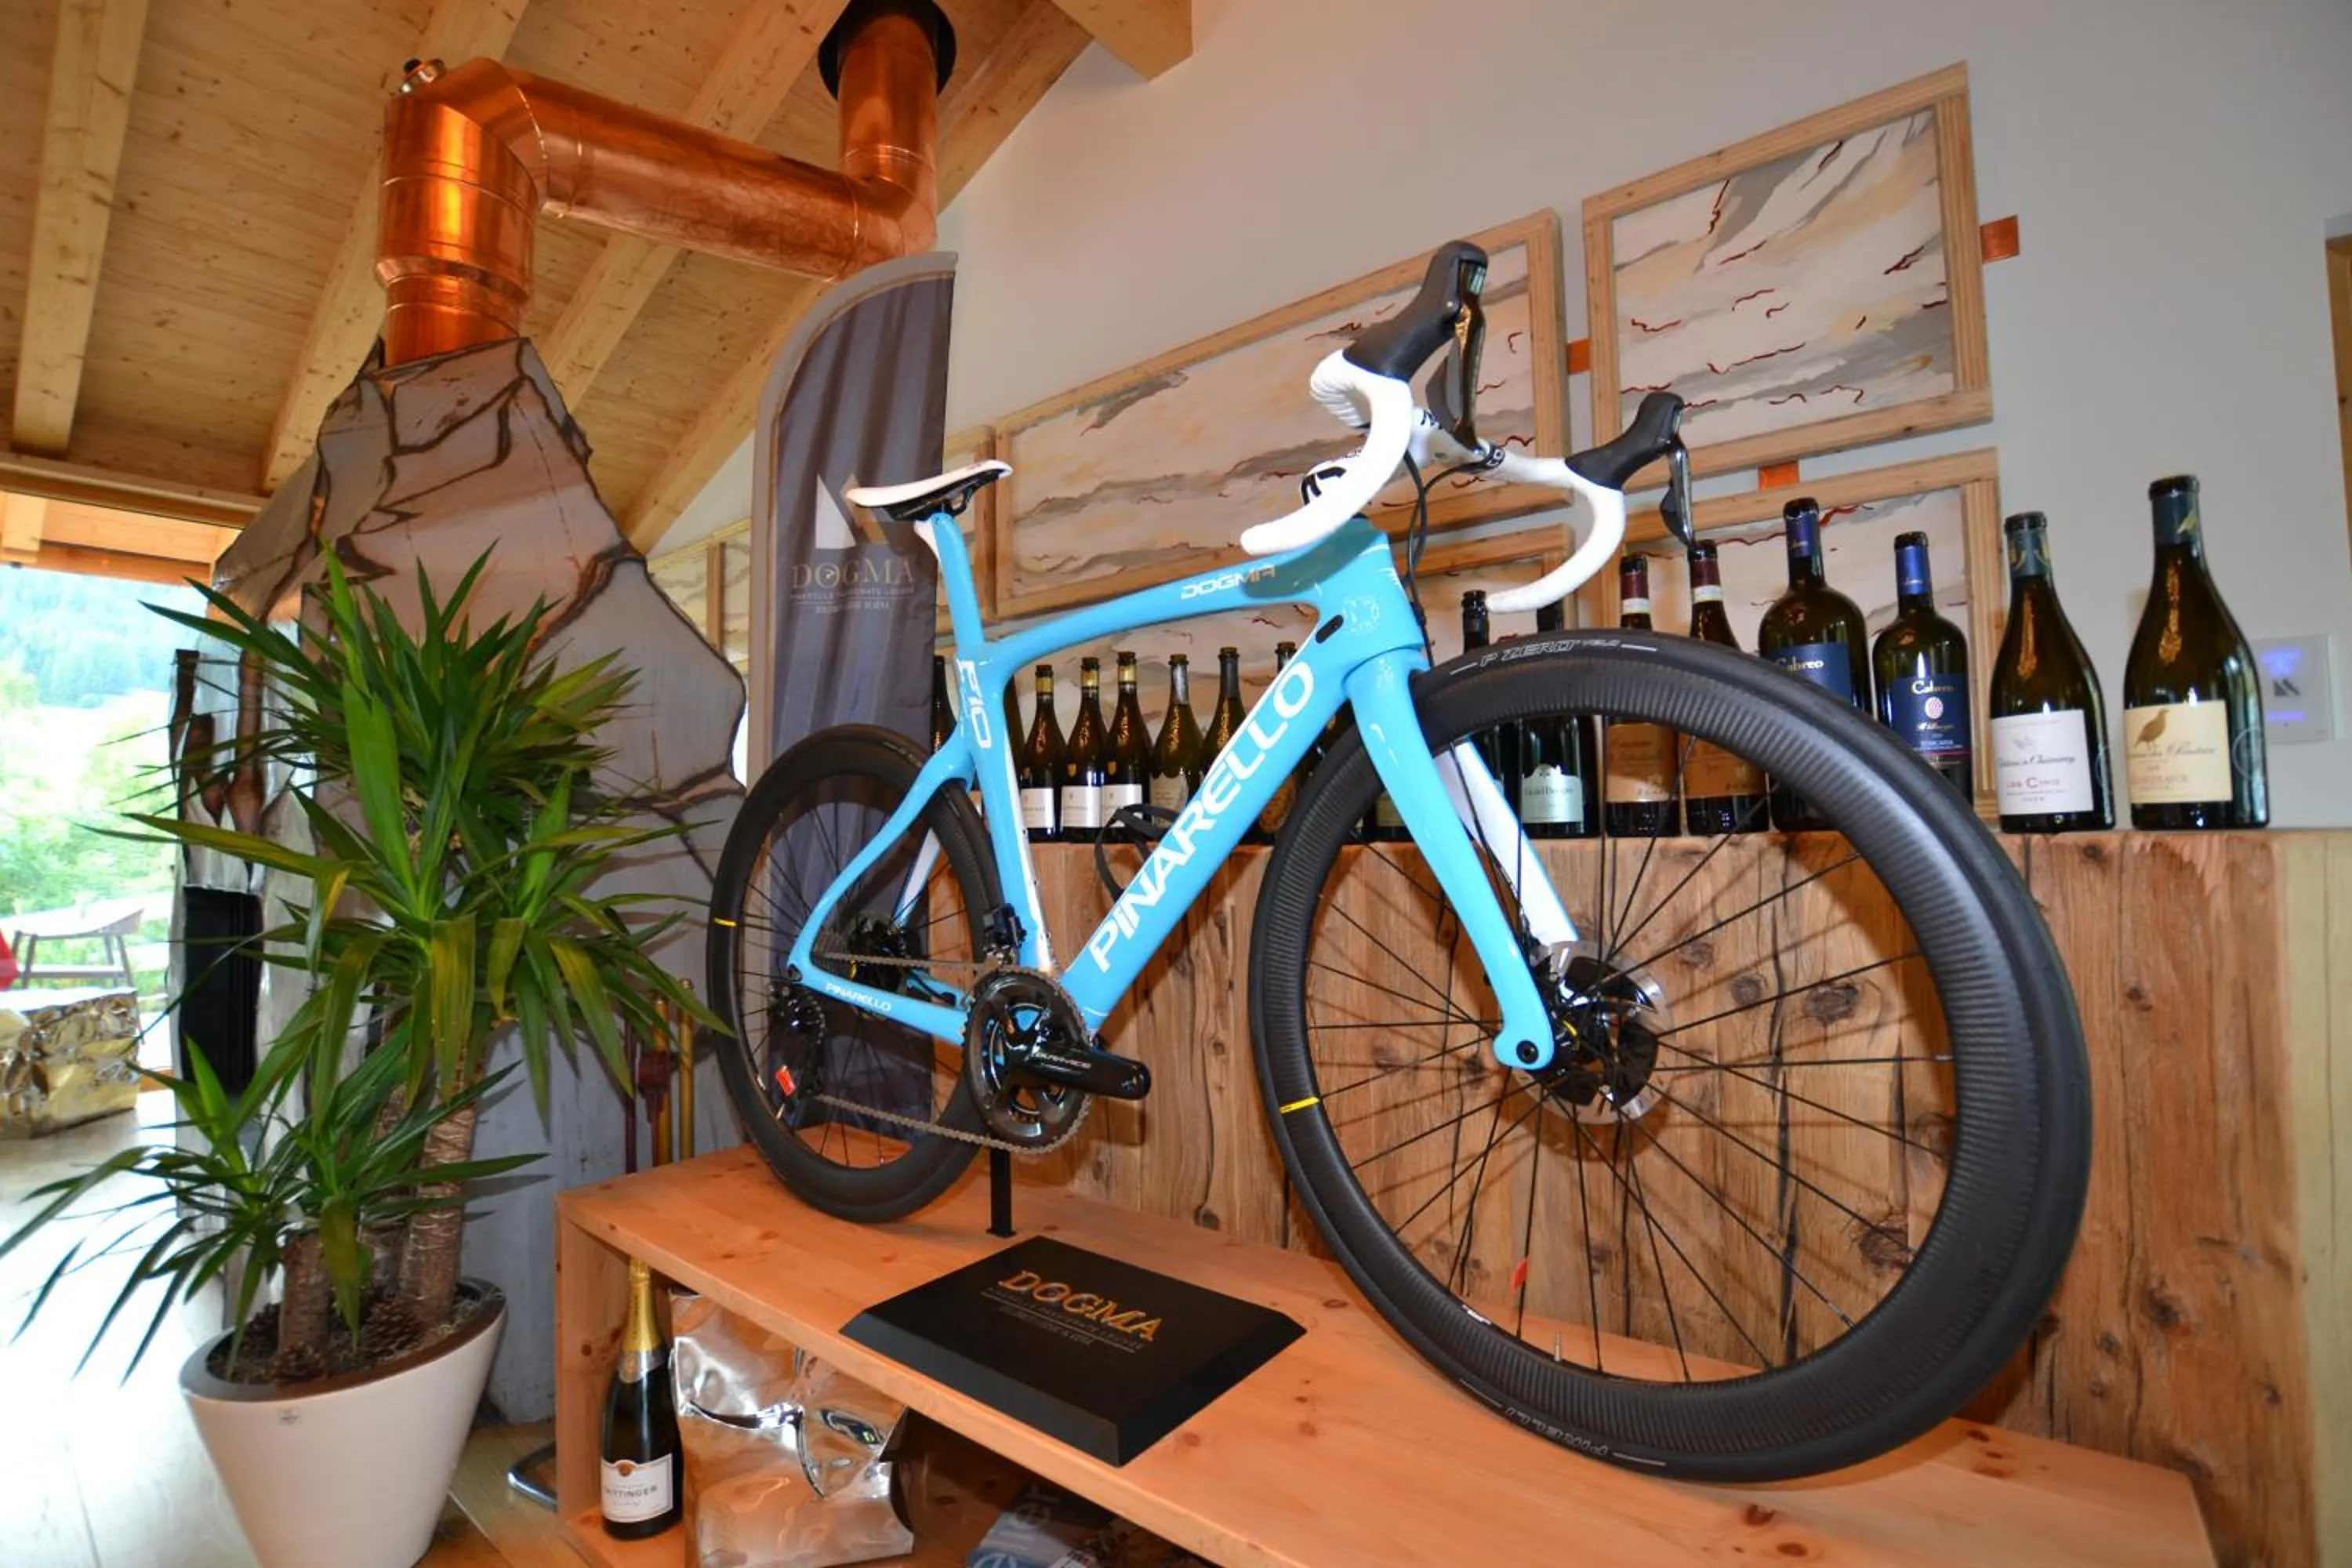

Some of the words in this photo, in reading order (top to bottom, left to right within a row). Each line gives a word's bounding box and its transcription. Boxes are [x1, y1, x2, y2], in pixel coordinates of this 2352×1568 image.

[791, 557, 914, 589] DOGMA
[1181, 564, 1276, 599] DOGMA
[1089, 661, 1315, 974] PINARELLO
[826, 982, 892, 1012] PINARELLO
[996, 1269, 1163, 1342] DOGMA
